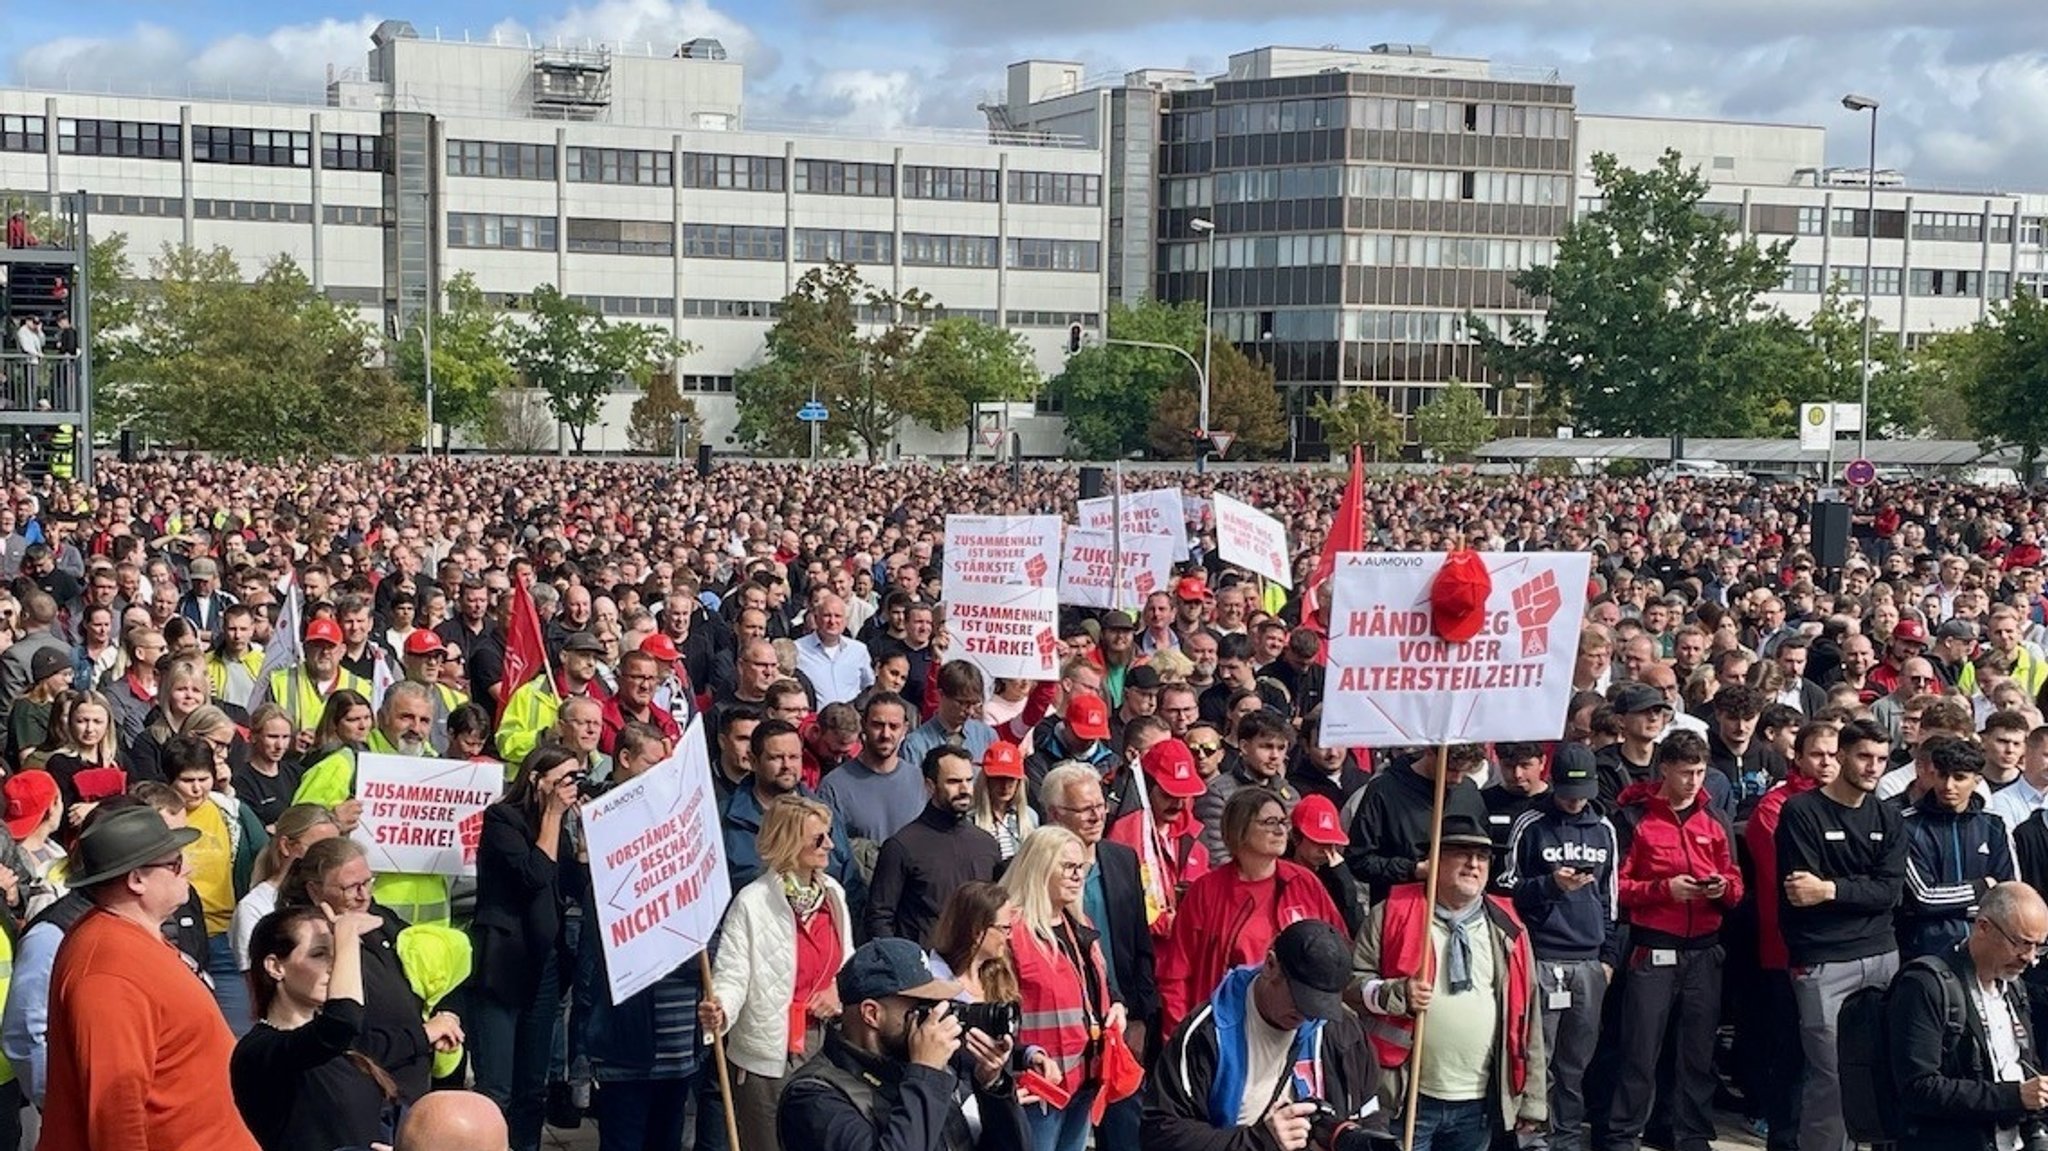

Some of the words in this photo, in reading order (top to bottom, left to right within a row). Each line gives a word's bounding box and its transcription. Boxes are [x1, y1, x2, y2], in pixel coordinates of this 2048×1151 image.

[1090, 510, 1133, 528] HÄNE
[953, 535, 1044, 546] ZUSAMMENHALT
[967, 548, 985, 558] IST
[987, 548, 1026, 558] UNSERE
[1365, 556, 1424, 567] AUMOVIO
[954, 559, 1016, 573] STÄRKSTE
[952, 603, 1053, 623] ZUSAMMENHALT
[961, 620, 982, 632] IST
[985, 621, 1033, 636] UNSERE
[965, 635, 1034, 657] STÄRKE!
[1399, 641, 1449, 663] VON
[1457, 640, 1502, 662] DER
[1338, 663, 1544, 691] ALTERSTEILZEIT!
[364, 781, 493, 806] ZUSAMMENHALT
[603, 785, 645, 814] AUMOVIO
[372, 802, 397, 818] IST
[399, 804, 456, 822] UNSERE
[375, 822, 454, 848] STÄRKE!
[605, 820, 678, 870] VORSTÄNDE
[633, 862, 678, 898] SOLLEN
[610, 893, 670, 948] NICHT
